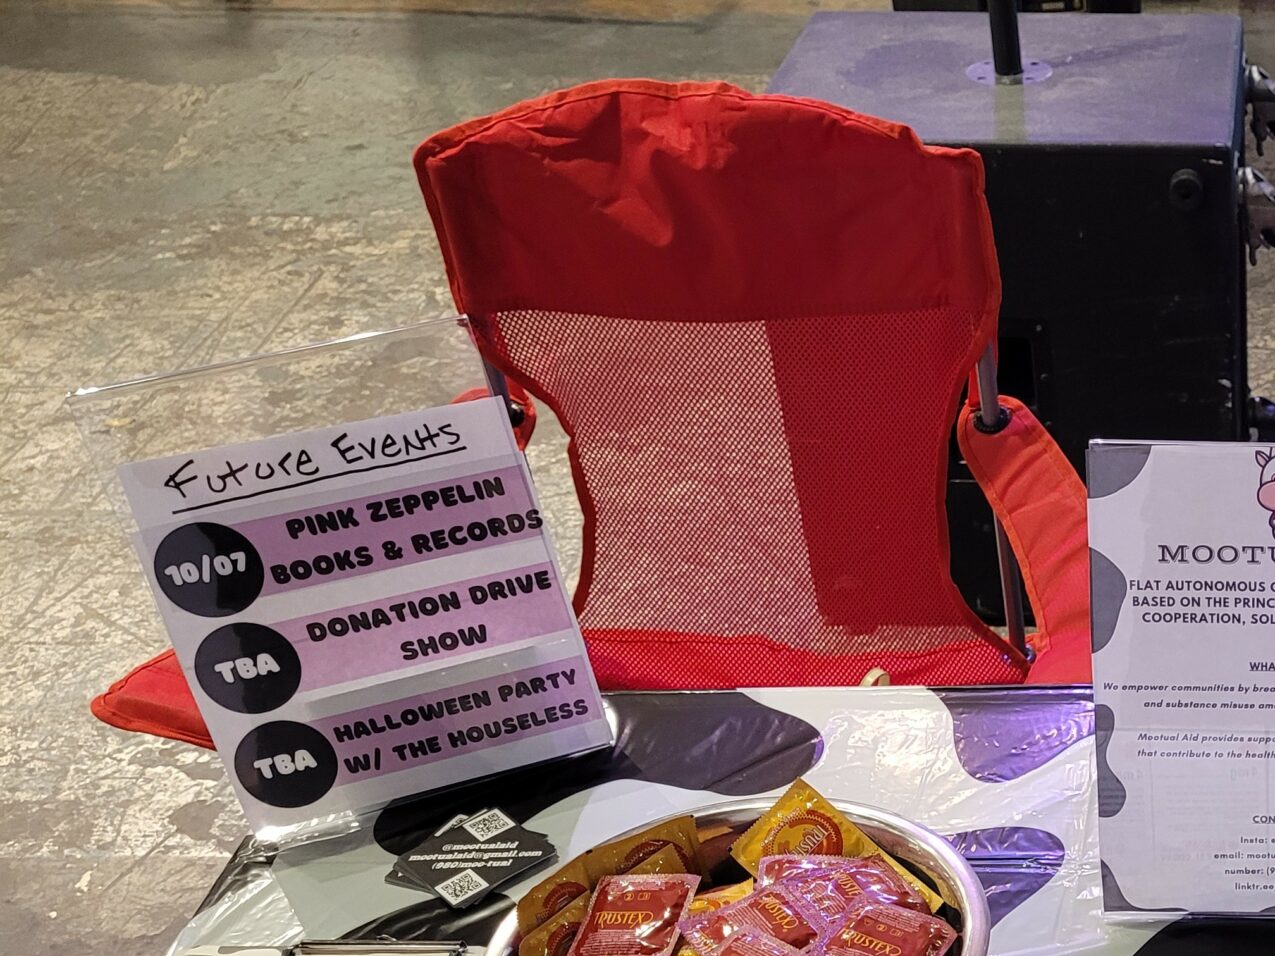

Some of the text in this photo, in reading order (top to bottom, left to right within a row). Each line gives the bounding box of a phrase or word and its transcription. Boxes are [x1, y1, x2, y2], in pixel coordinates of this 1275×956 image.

[163, 422, 462, 499] Future Events
[284, 475, 505, 540] PINK ZEPPELIN
[269, 507, 543, 584] BOOKS & RECORDS
[163, 551, 248, 588] 10/07
[1128, 579, 1161, 591] FLAT
[1164, 579, 1266, 592] AUTONOMOUS
[305, 569, 552, 642] DONATION DRIVE
[1131, 595, 1176, 607] BASED
[1179, 596, 1201, 607] ON
[1204, 596, 1229, 608] THE
[1141, 611, 1246, 626] COOPERATION,
[399, 623, 487, 660] SHOW
[214, 652, 281, 686] TBA
[1121, 684, 1169, 693] empower
[1170, 683, 1235, 692] communities
[1143, 698, 1163, 707] and
[1165, 698, 1217, 708] substance
[1219, 700, 1255, 709] misuse
[332, 667, 576, 743] HALLOWEEN PARTY
[342, 698, 589, 774] W/ THE HOUSELESS
[1136, 732, 1179, 741] Mootual
[1180, 732, 1199, 741] Aid
[1200, 732, 1244, 744] provides
[252, 748, 319, 781] TBA
[1136, 747, 1157, 757] that
[1159, 748, 1211, 758] contribute
[1226, 749, 1242, 758] the
[1244, 749, 1275, 759] health
[595, 911, 653, 928] TRUSTEX
